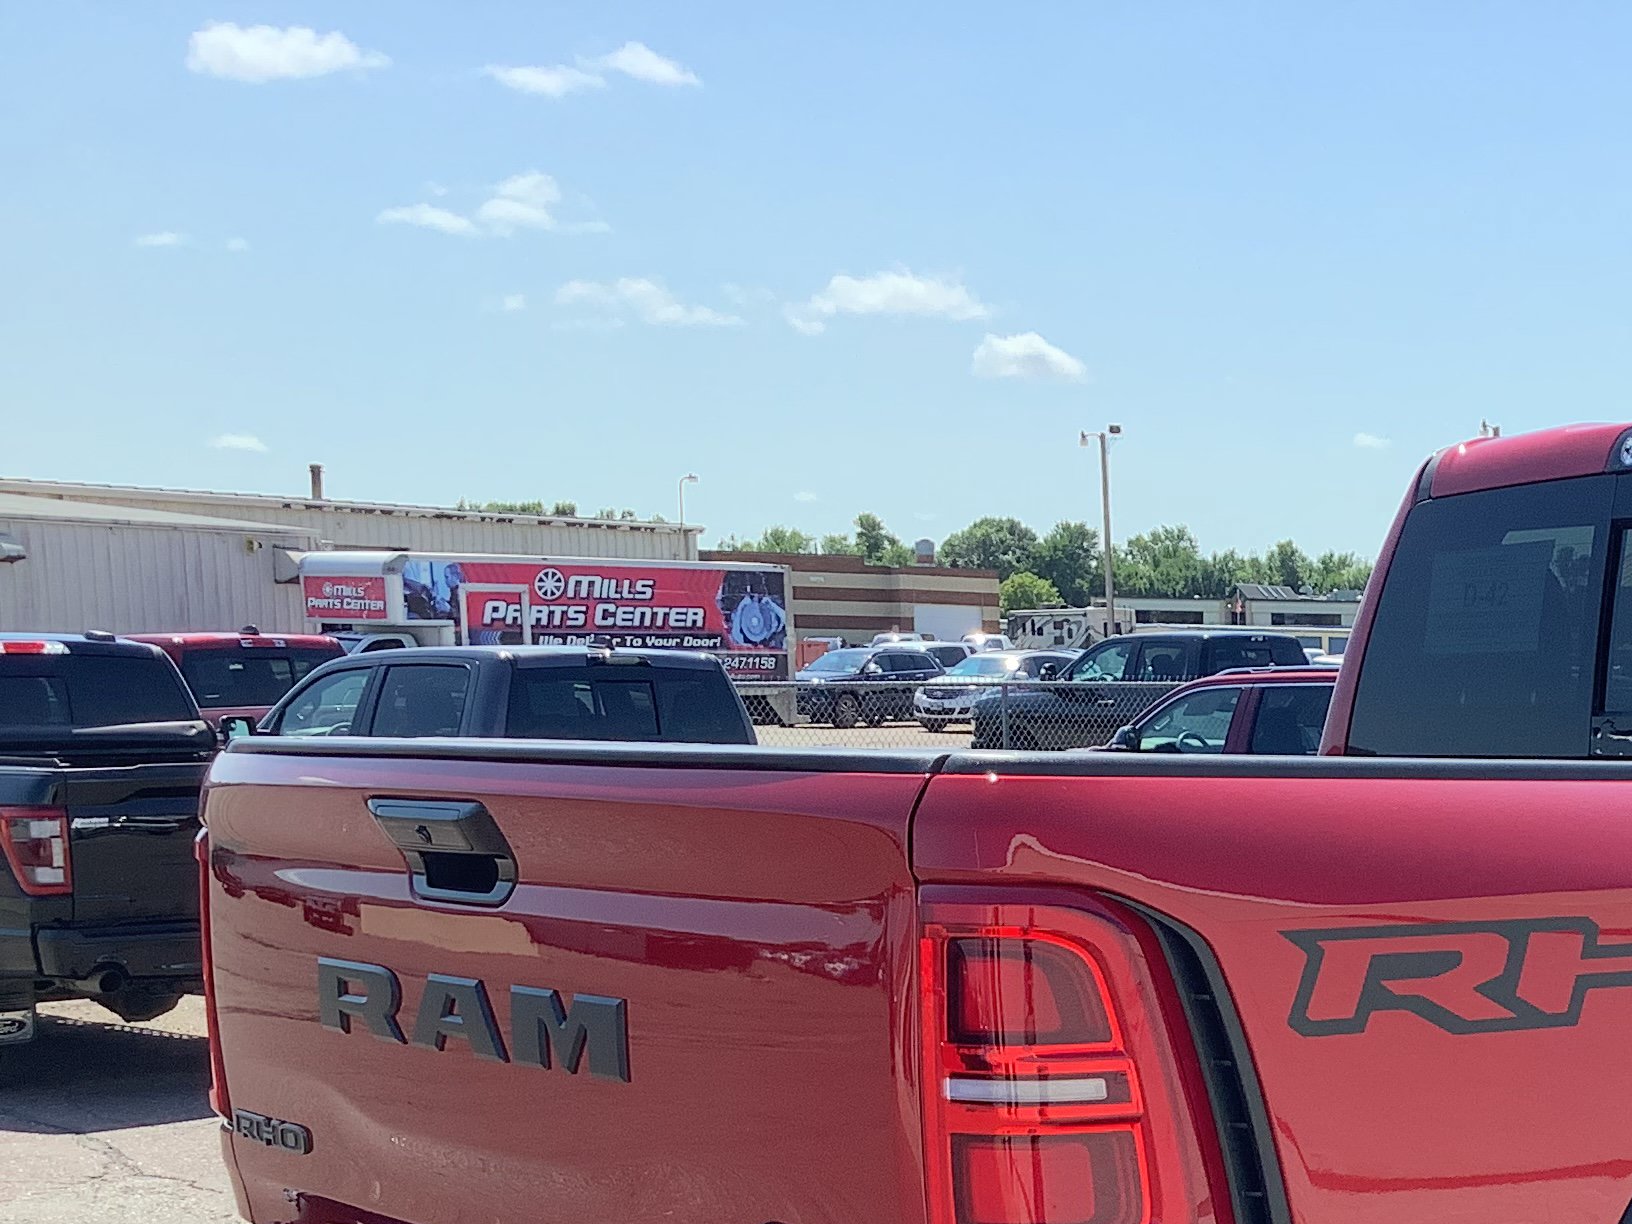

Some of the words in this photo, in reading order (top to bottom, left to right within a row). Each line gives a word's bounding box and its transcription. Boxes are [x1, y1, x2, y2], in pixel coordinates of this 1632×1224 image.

[566, 575, 654, 600] MILLS
[307, 597, 341, 609] PARTS
[343, 598, 384, 610] CENTER
[594, 603, 704, 628] CENTER
[625, 636, 642, 646] To
[646, 636, 680, 647] Your
[317, 956, 632, 1083] RAM
[233, 1107, 314, 1156] RHO
